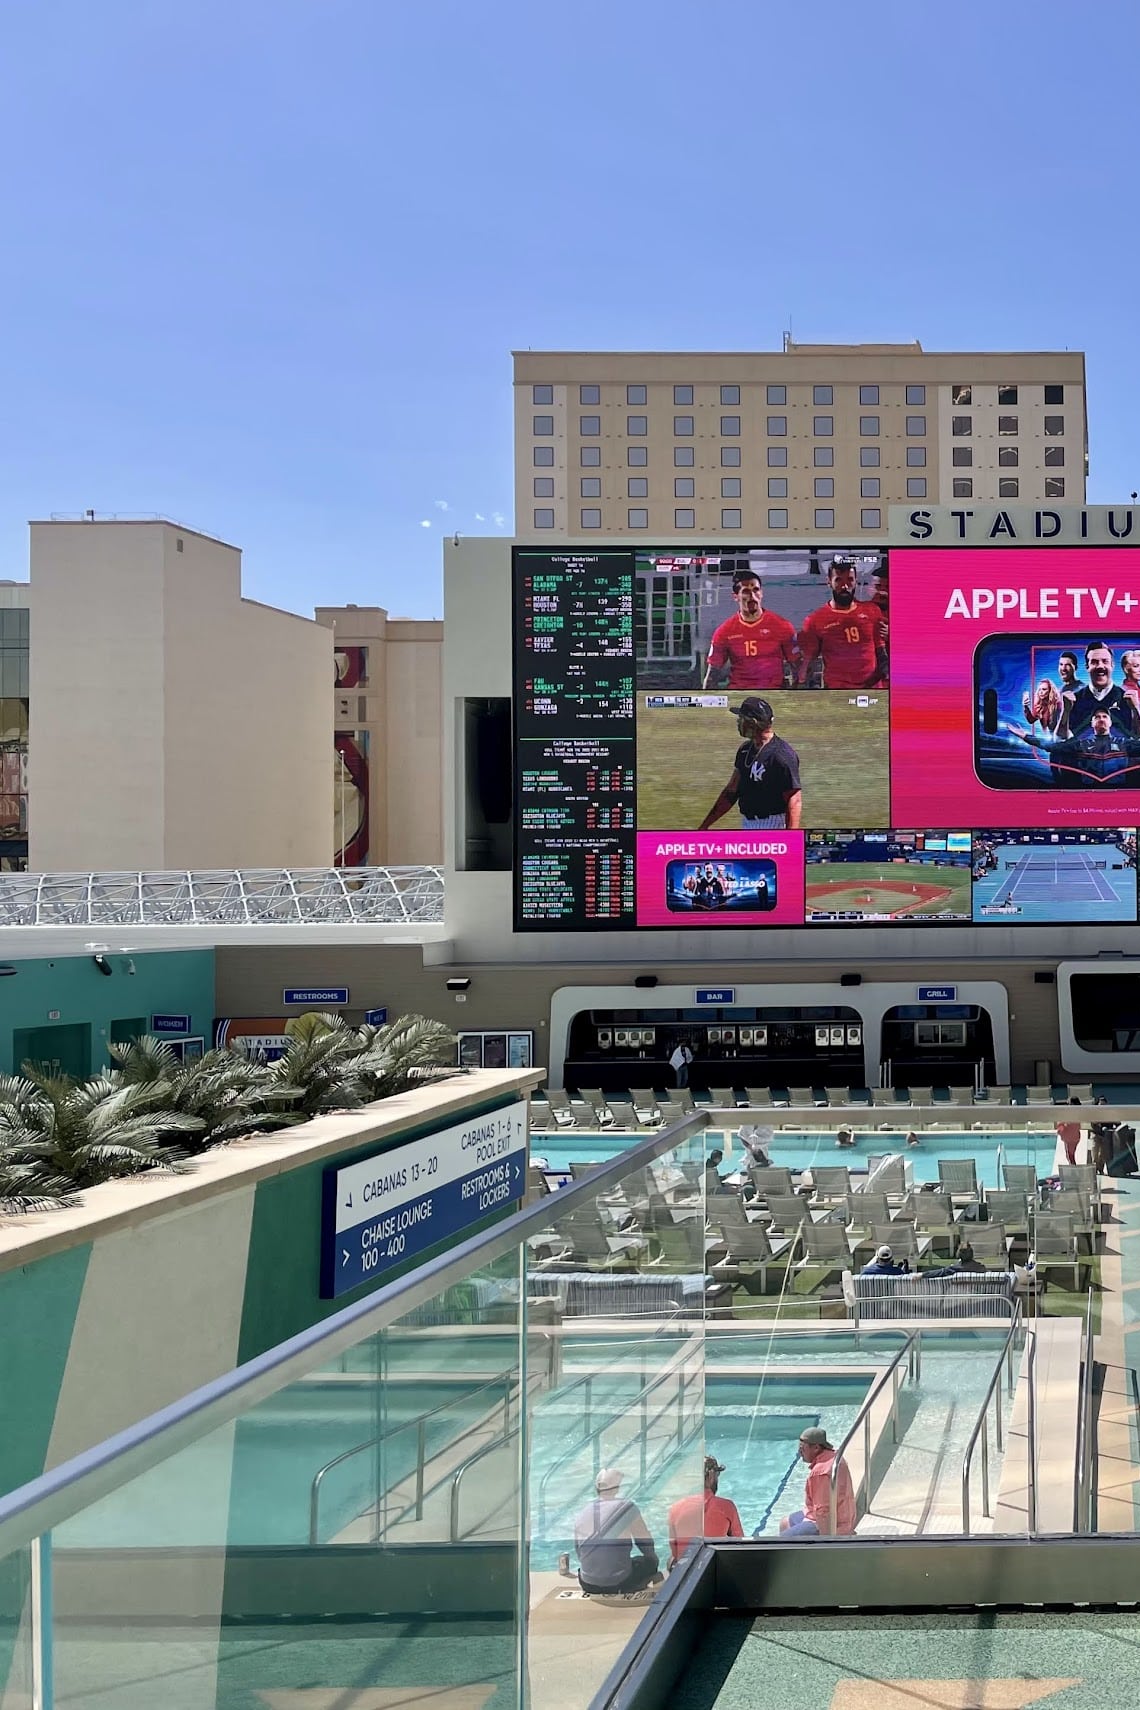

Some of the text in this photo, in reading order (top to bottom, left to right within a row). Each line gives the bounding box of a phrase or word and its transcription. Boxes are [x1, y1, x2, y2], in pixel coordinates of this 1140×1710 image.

[943, 588, 1060, 619] APPLE
[1066, 587, 1139, 618] TV+
[743, 641, 758, 656] 15
[844, 626, 859, 642] 19
[655, 843, 787, 855] APPLE TV+ INCLUDED
[157, 1020, 184, 1028] WOMEN
[461, 1124, 495, 1150] CABANAS
[476, 1135, 511, 1164] POOL EXIT
[362, 1169, 407, 1202] CABANAS
[461, 1162, 511, 1200] RESTROOMS &
[479, 1181, 511, 1211] LOCKERS
[361, 1199, 433, 1249] CHAISE LOUNGE
[361, 1248, 378, 1272] 100
[387, 1234, 405, 1258] 400
